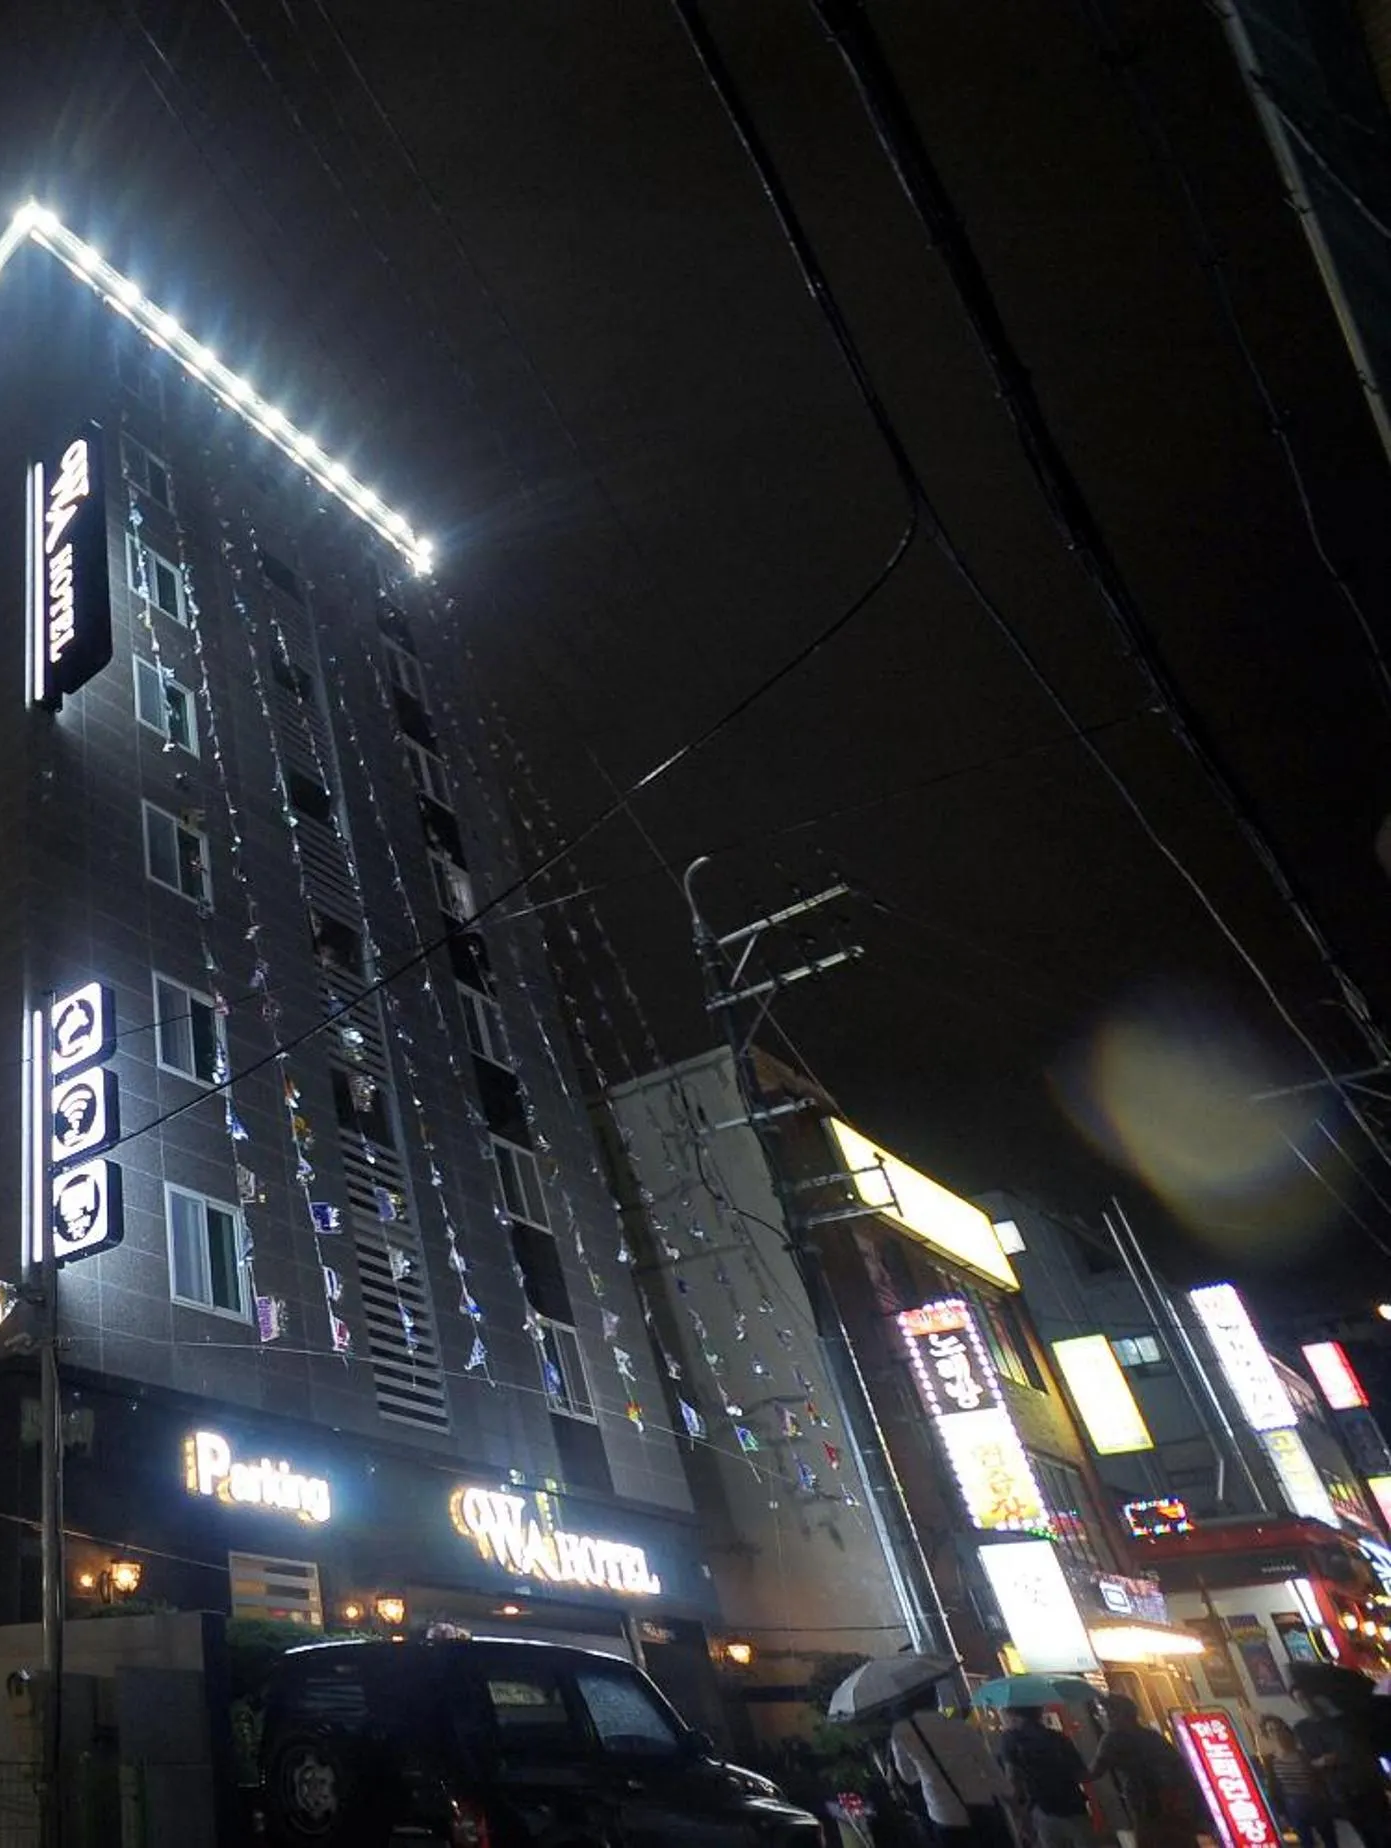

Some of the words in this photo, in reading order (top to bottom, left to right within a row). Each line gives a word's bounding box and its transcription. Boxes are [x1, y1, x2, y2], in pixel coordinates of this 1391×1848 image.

[48, 542, 75, 664] HOTEL
[194, 1431, 331, 1522] Parking
[553, 1529, 661, 1595] HOTEL
